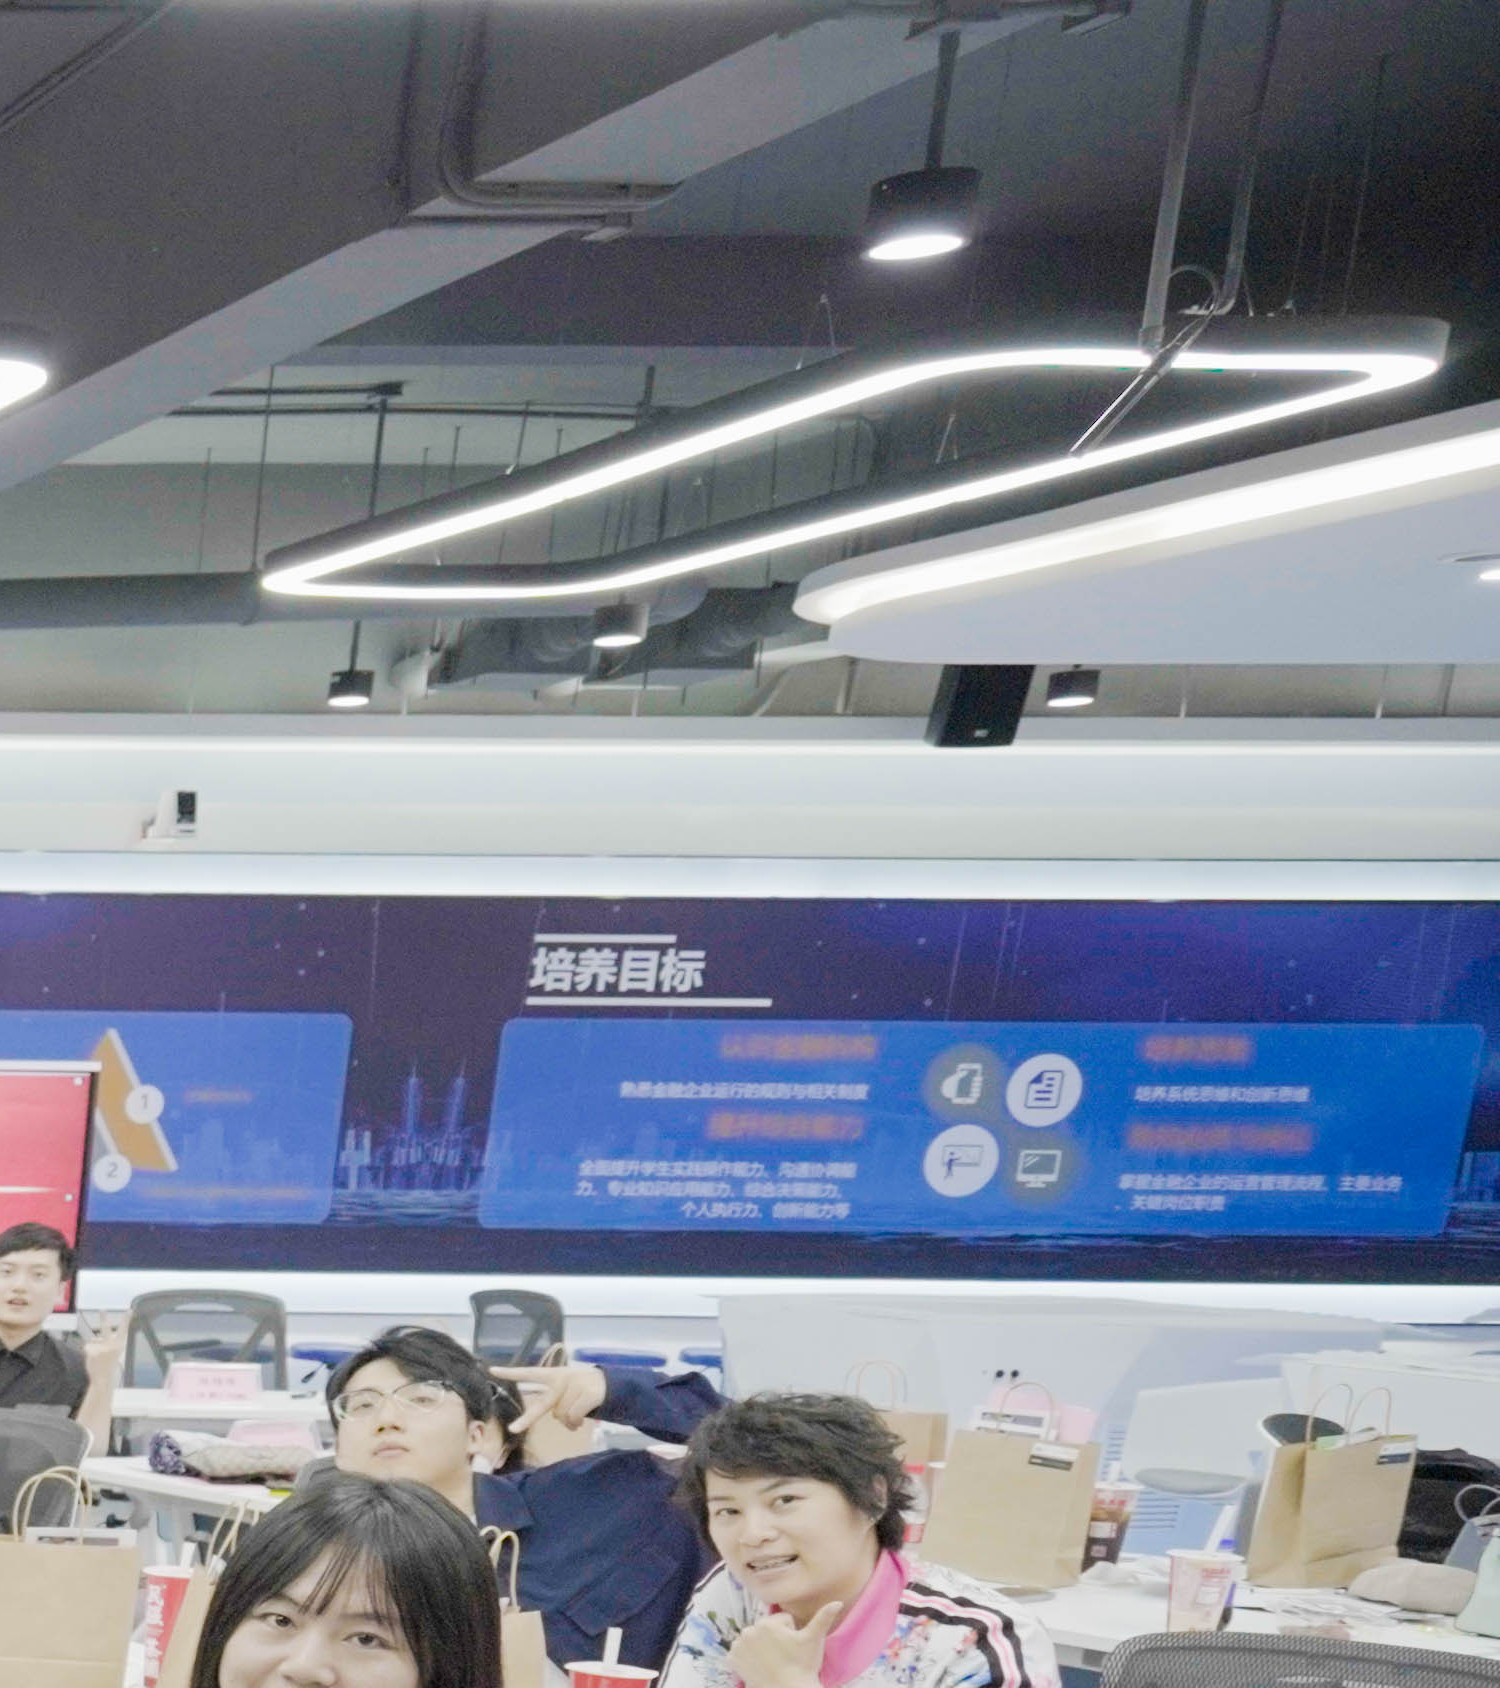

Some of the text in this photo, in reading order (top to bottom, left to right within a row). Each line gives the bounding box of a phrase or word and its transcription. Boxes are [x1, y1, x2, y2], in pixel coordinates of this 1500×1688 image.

[529, 947, 705, 993] 培养目标
[106, 1162, 118, 1178] 2
